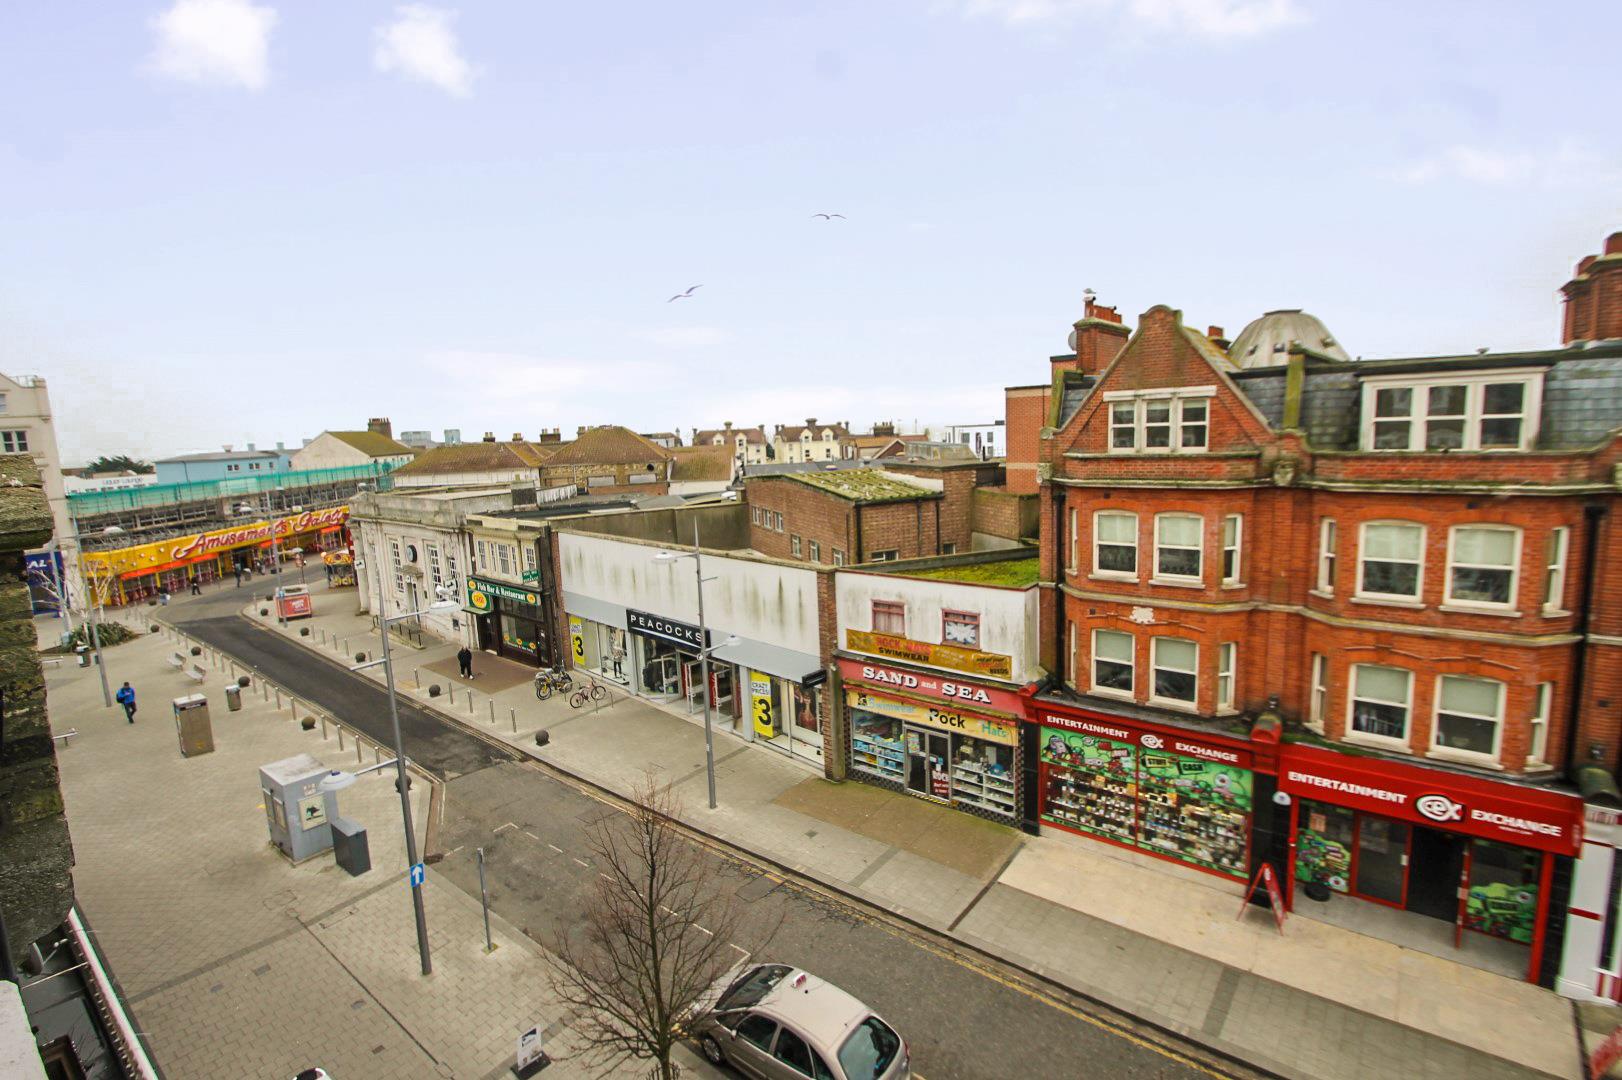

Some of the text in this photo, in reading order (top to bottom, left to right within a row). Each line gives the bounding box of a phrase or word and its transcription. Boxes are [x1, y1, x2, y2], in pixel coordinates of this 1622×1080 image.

[172, 517, 288, 560] Amusements
[27, 559, 48, 569] AL
[487, 584, 495, 593] Bar
[495, 587, 500, 595] &
[501, 587, 526, 600] Restaurant
[630, 614, 702, 642] PEACOCKS
[879, 647, 930, 662] SWIMWEAR
[862, 666, 992, 704] SAND and SEA
[1047, 715, 1129, 739] ENTERTAINMENT
[1175, 742, 1239, 763] EXCHANGE
[1287, 770, 1407, 805] ENTERTAINMENT
[1471, 809, 1562, 838] EXCHANGE
